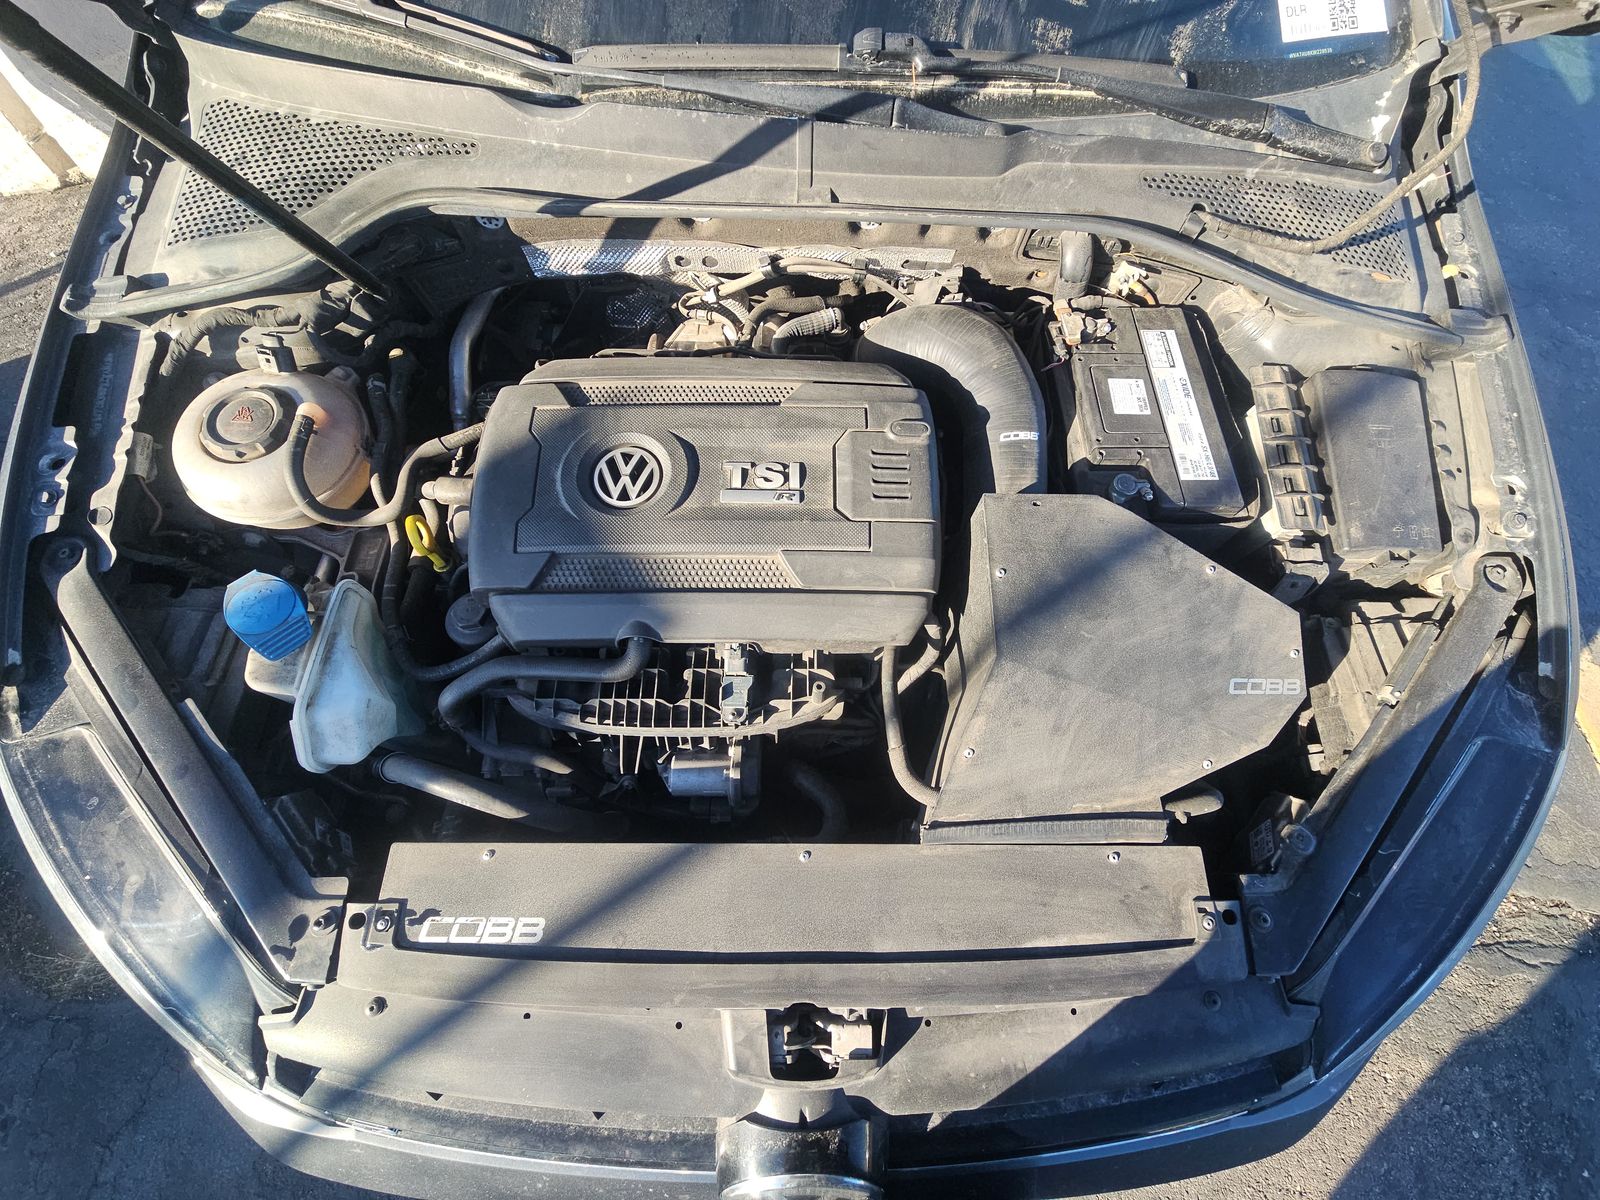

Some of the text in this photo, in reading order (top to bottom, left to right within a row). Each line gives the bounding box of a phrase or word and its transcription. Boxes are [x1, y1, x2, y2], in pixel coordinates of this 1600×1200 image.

[1285, 4, 1308, 18] DLR
[999, 431, 1040, 442] COBB
[596, 448, 658, 507] VW
[723, 461, 801, 490] TSI
[772, 491, 796, 502] R
[1229, 677, 1301, 695] COBB
[417, 916, 546, 944] COBB
